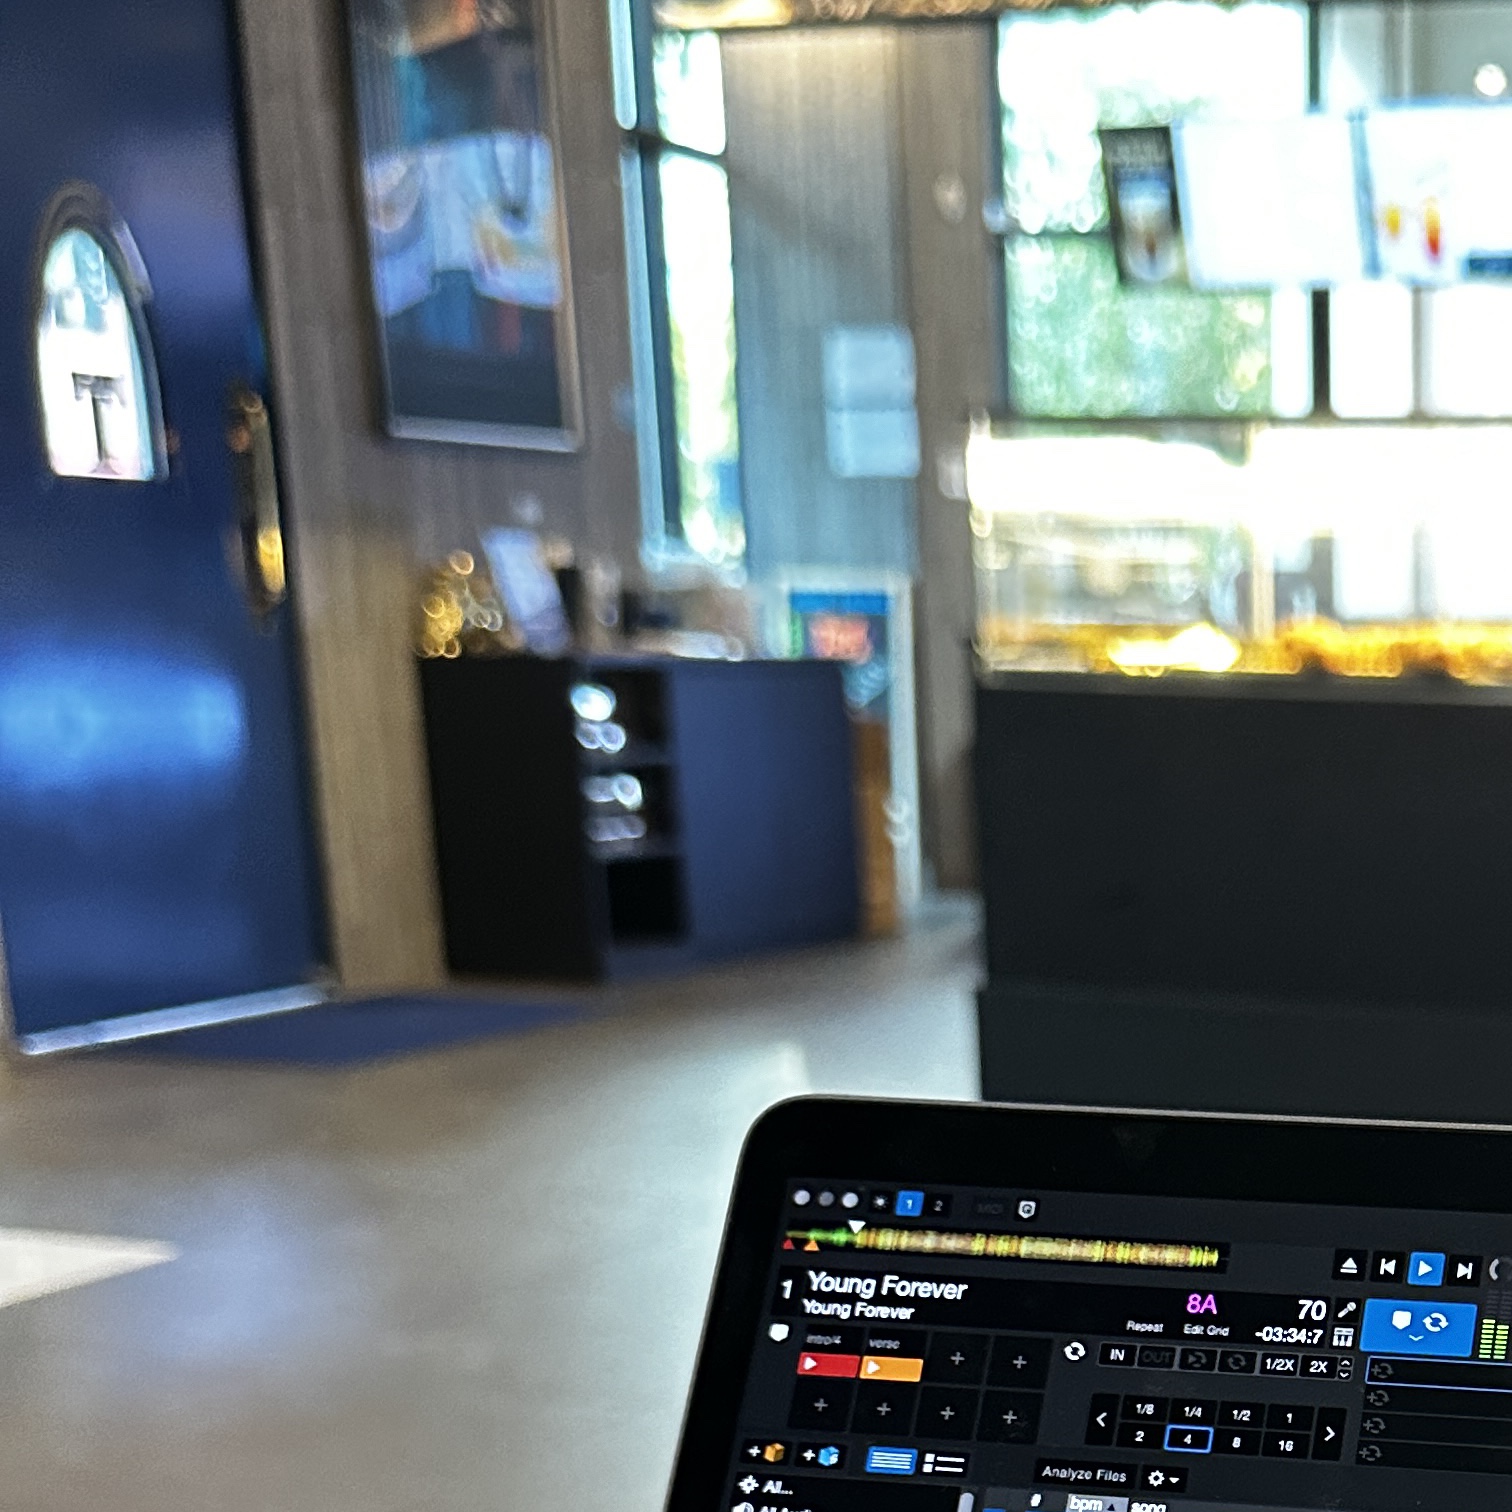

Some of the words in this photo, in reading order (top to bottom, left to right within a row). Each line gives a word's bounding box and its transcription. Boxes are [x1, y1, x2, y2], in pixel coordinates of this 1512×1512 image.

[782, 1279, 792, 1299] 1
[807, 1270, 876, 1299] Young
[880, 1274, 968, 1300] Forever
[802, 1298, 852, 1319] Young
[854, 1301, 915, 1320] Forever
[1186, 1293, 1217, 1315] 8A
[1298, 1299, 1327, 1321] 70
[1126, 1320, 1163, 1332] Repeat
[1183, 1323, 1204, 1335] Edit
[1206, 1325, 1229, 1336] Grid
[1255, 1326, 1324, 1344] -03:34:7
[869, 1339, 900, 1349] verse
[1109, 1348, 1125, 1361] IN
[1265, 1358, 1294, 1371] 1/2X
[1309, 1360, 1328, 1373] 2X
[1136, 1403, 1154, 1415] 1/8
[1184, 1406, 1202, 1417] 1/4
[1232, 1409, 1251, 1421] 1/2
[1286, 1413, 1292, 1423] 1
[1134, 1430, 1144, 1442] 2
[1184, 1434, 1191, 1444] 4
[1232, 1437, 1241, 1448] 8
[1278, 1440, 1294, 1452] 16
[1041, 1465, 1092, 1481] Analyze
[1096, 1469, 1126, 1482] Files
[1030, 1493, 1041, 1507] #
